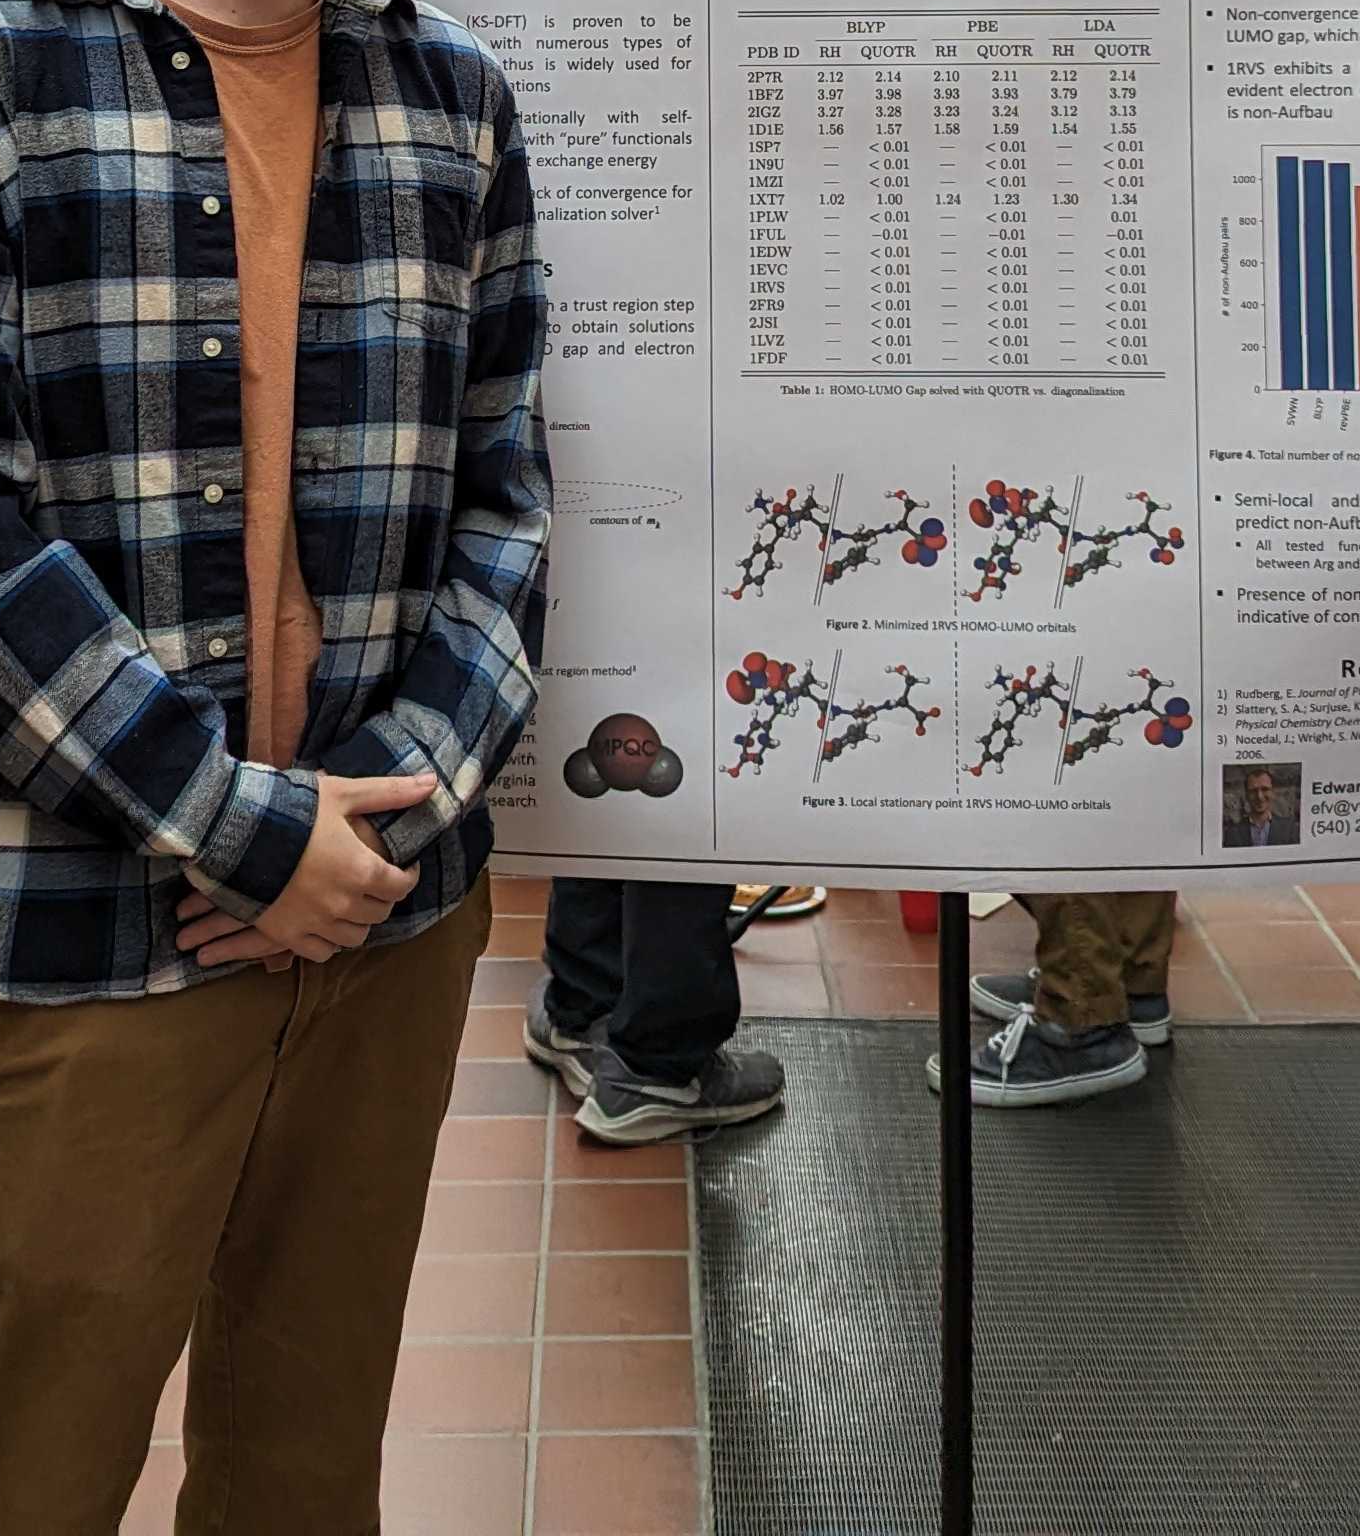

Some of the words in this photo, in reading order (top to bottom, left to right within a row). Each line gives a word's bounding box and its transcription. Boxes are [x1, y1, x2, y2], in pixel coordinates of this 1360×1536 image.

[467, 14, 527, 31] (KS-DFT)
[545, 15, 555, 28] is
[573, 18, 622, 30] proven
[641, 16, 655, 27] to
[674, 14, 691, 26] be
[1227, 8, 1358, 23] Non-convergence
[847, 22, 885, 33] BLYP
[968, 21, 998, 32] PBE
[1084, 20, 1115, 31] LDA
[490, 36, 521, 49] with
[537, 39, 608, 49] numerous
[623, 37, 662, 51] types
[677, 35, 692, 48] of
[1227, 30, 1273, 42] LUMO
[1278, 32, 1309, 45] gap,
[1314, 28, 1359, 41] which
[748, 47, 778, 58] PDB
[784, 47, 799, 58] ID
[820, 46, 841, 58] RH
[861, 46, 916, 60] QUOTR
[936, 45, 957, 57] RH
[977, 45, 1033, 59] QUOTR
[1053, 45, 1074, 56] RH
[1095, 44, 1151, 59] QUOTR
[1228, 62, 1265, 75] 1RVS
[1274, 61, 1333, 75] exhibits
[1342, 65, 1351, 74] a
[748, 72, 783, 83] 2P7R
[818, 72, 843, 82] 2.12
[875, 71, 901, 82] 2.14
[934, 71, 959, 82] 2.10
[992, 70, 1018, 82] 2.11
[1051, 70, 1077, 81] 2.12
[1110, 70, 1136, 81] 2.14
[1227, 83, 1283, 97] evident
[1290, 83, 1352, 96] electron
[1228, 106, 1239, 118] is
[1244, 105, 1332, 118] non-Aufbau
[1232, 175, 1256, 184] 1000
[827, 619, 858, 631] Figure
[875, 620, 928, 630] Minimized
[932, 621, 958, 630] 1RVS
[961, 621, 1034, 632] HOMO-LUMO
[1037, 622, 1076, 632] orbitals
[1311, 820, 1350, 837] (540)
